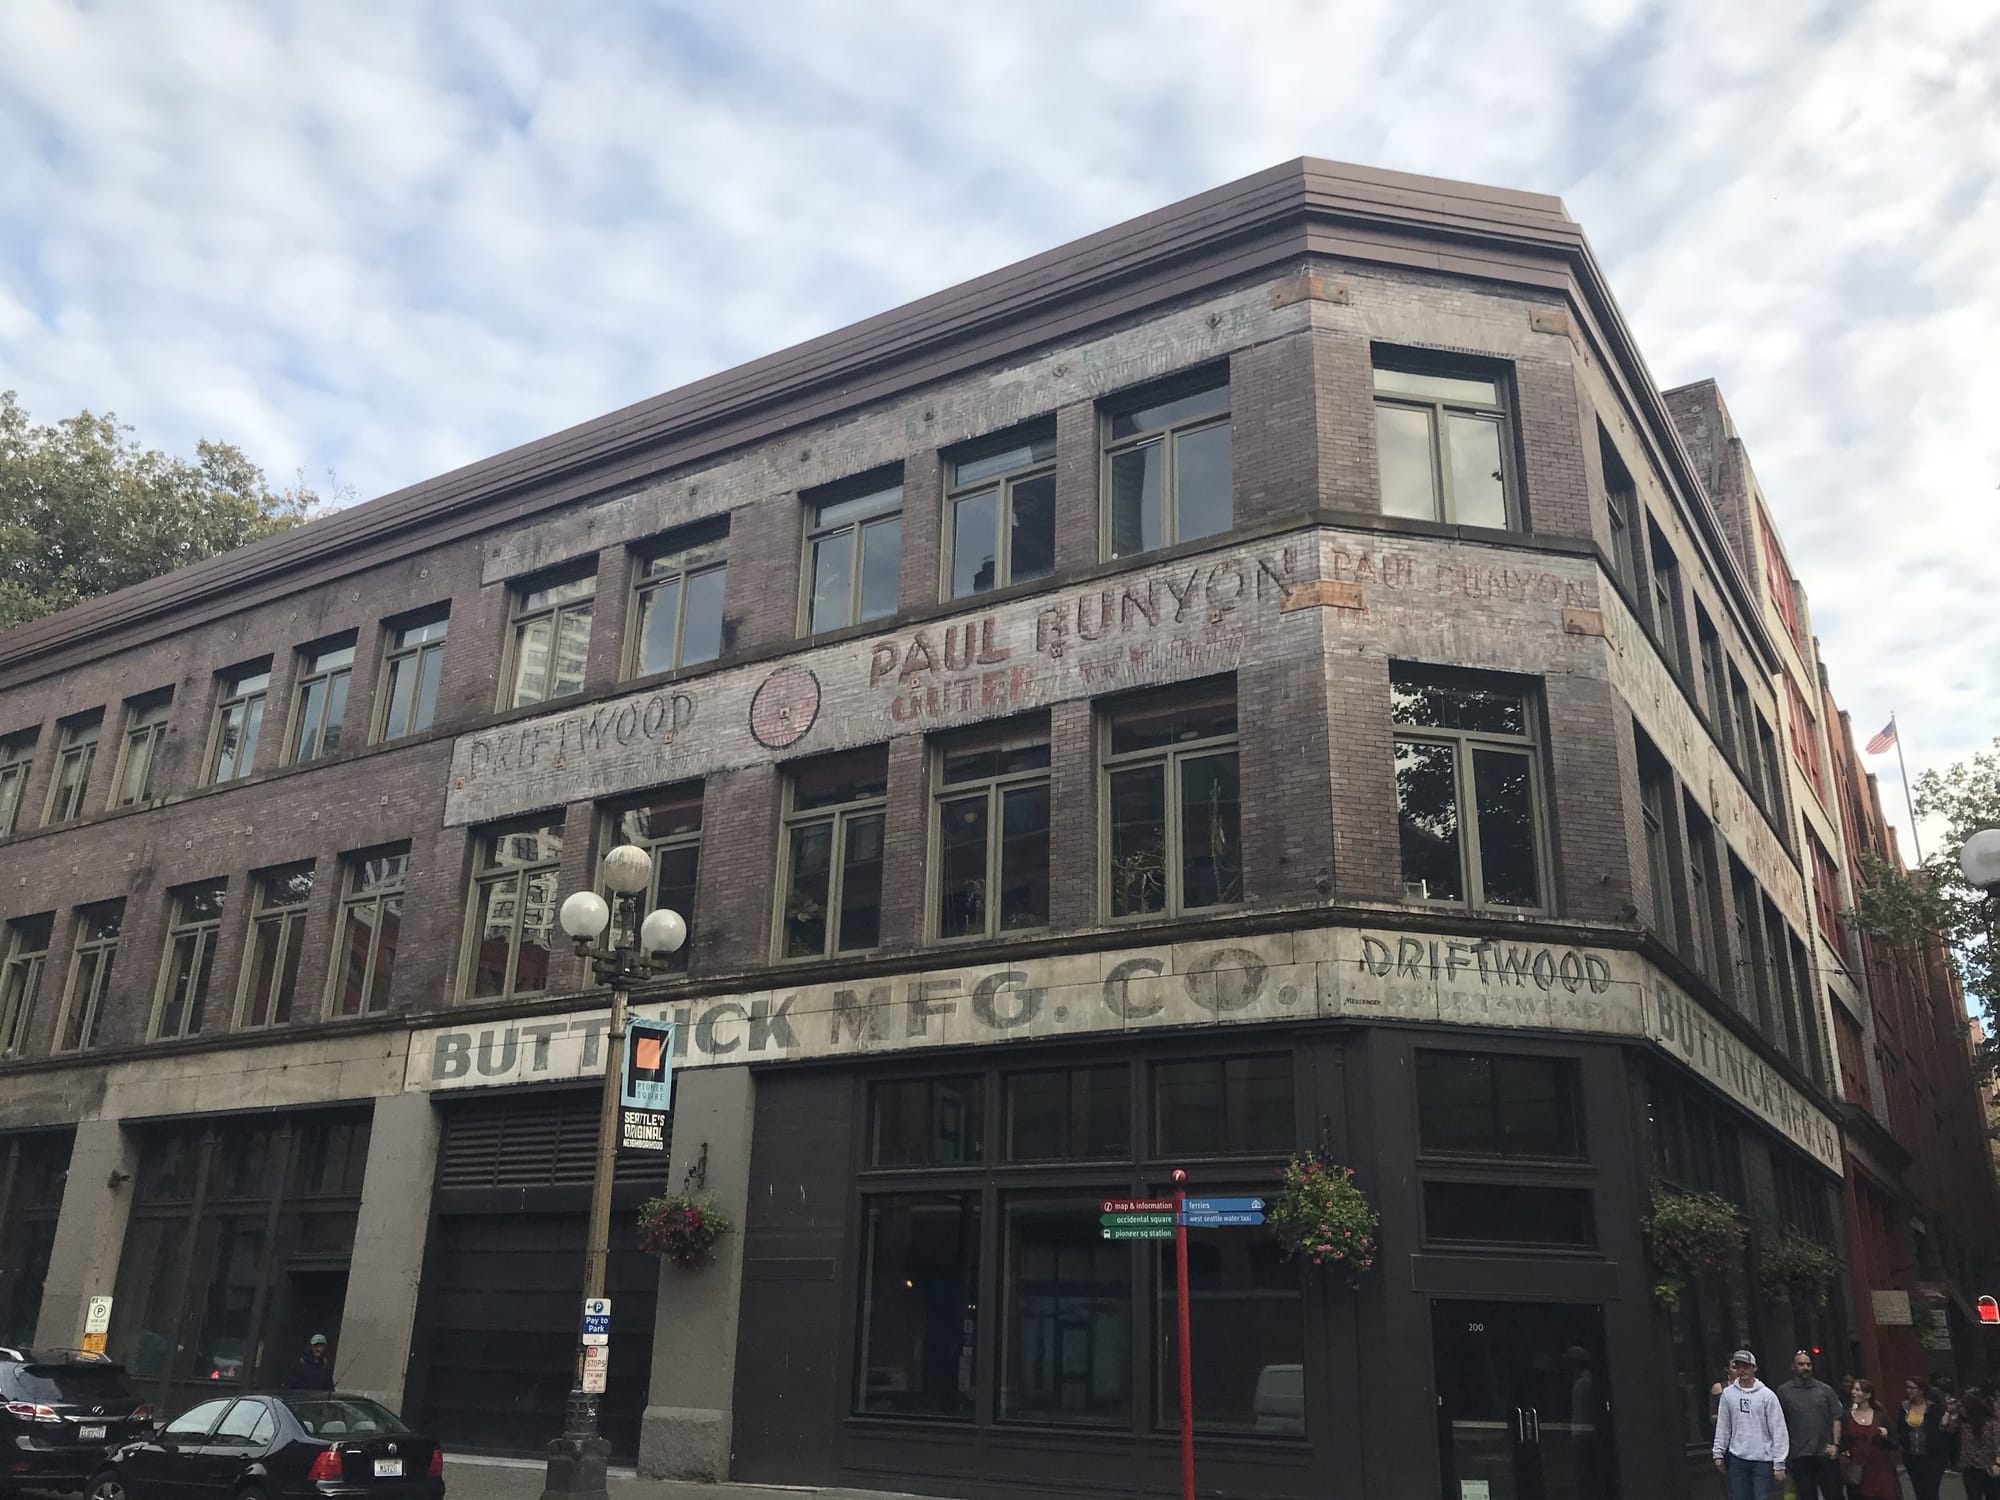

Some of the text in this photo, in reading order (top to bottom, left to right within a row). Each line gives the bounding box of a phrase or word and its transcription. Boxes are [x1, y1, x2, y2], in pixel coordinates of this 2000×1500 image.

[869, 616, 1011, 689] PAUL
[1036, 547, 1296, 653] BUNYON
[470, 690, 698, 779] DRIFTWOOD
[1361, 934, 1612, 995] DRIFTWOOD
[432, 947, 1299, 1081] BUTTICK MFG. CO.
[624, 1111, 665, 1126] SEATTLE'S
[624, 1124, 663, 1140] ORIGINAL
[1115, 1203, 1128, 1211] map
[1136, 1202, 1173, 1210] information
[1116, 1215, 1172, 1224] occidental square
[1115, 1229, 1139, 1238] pioneer
[586, 1316, 599, 1325] Pay
[588, 1325, 605, 1333] Park
[1468, 1323, 1484, 1331] 200
